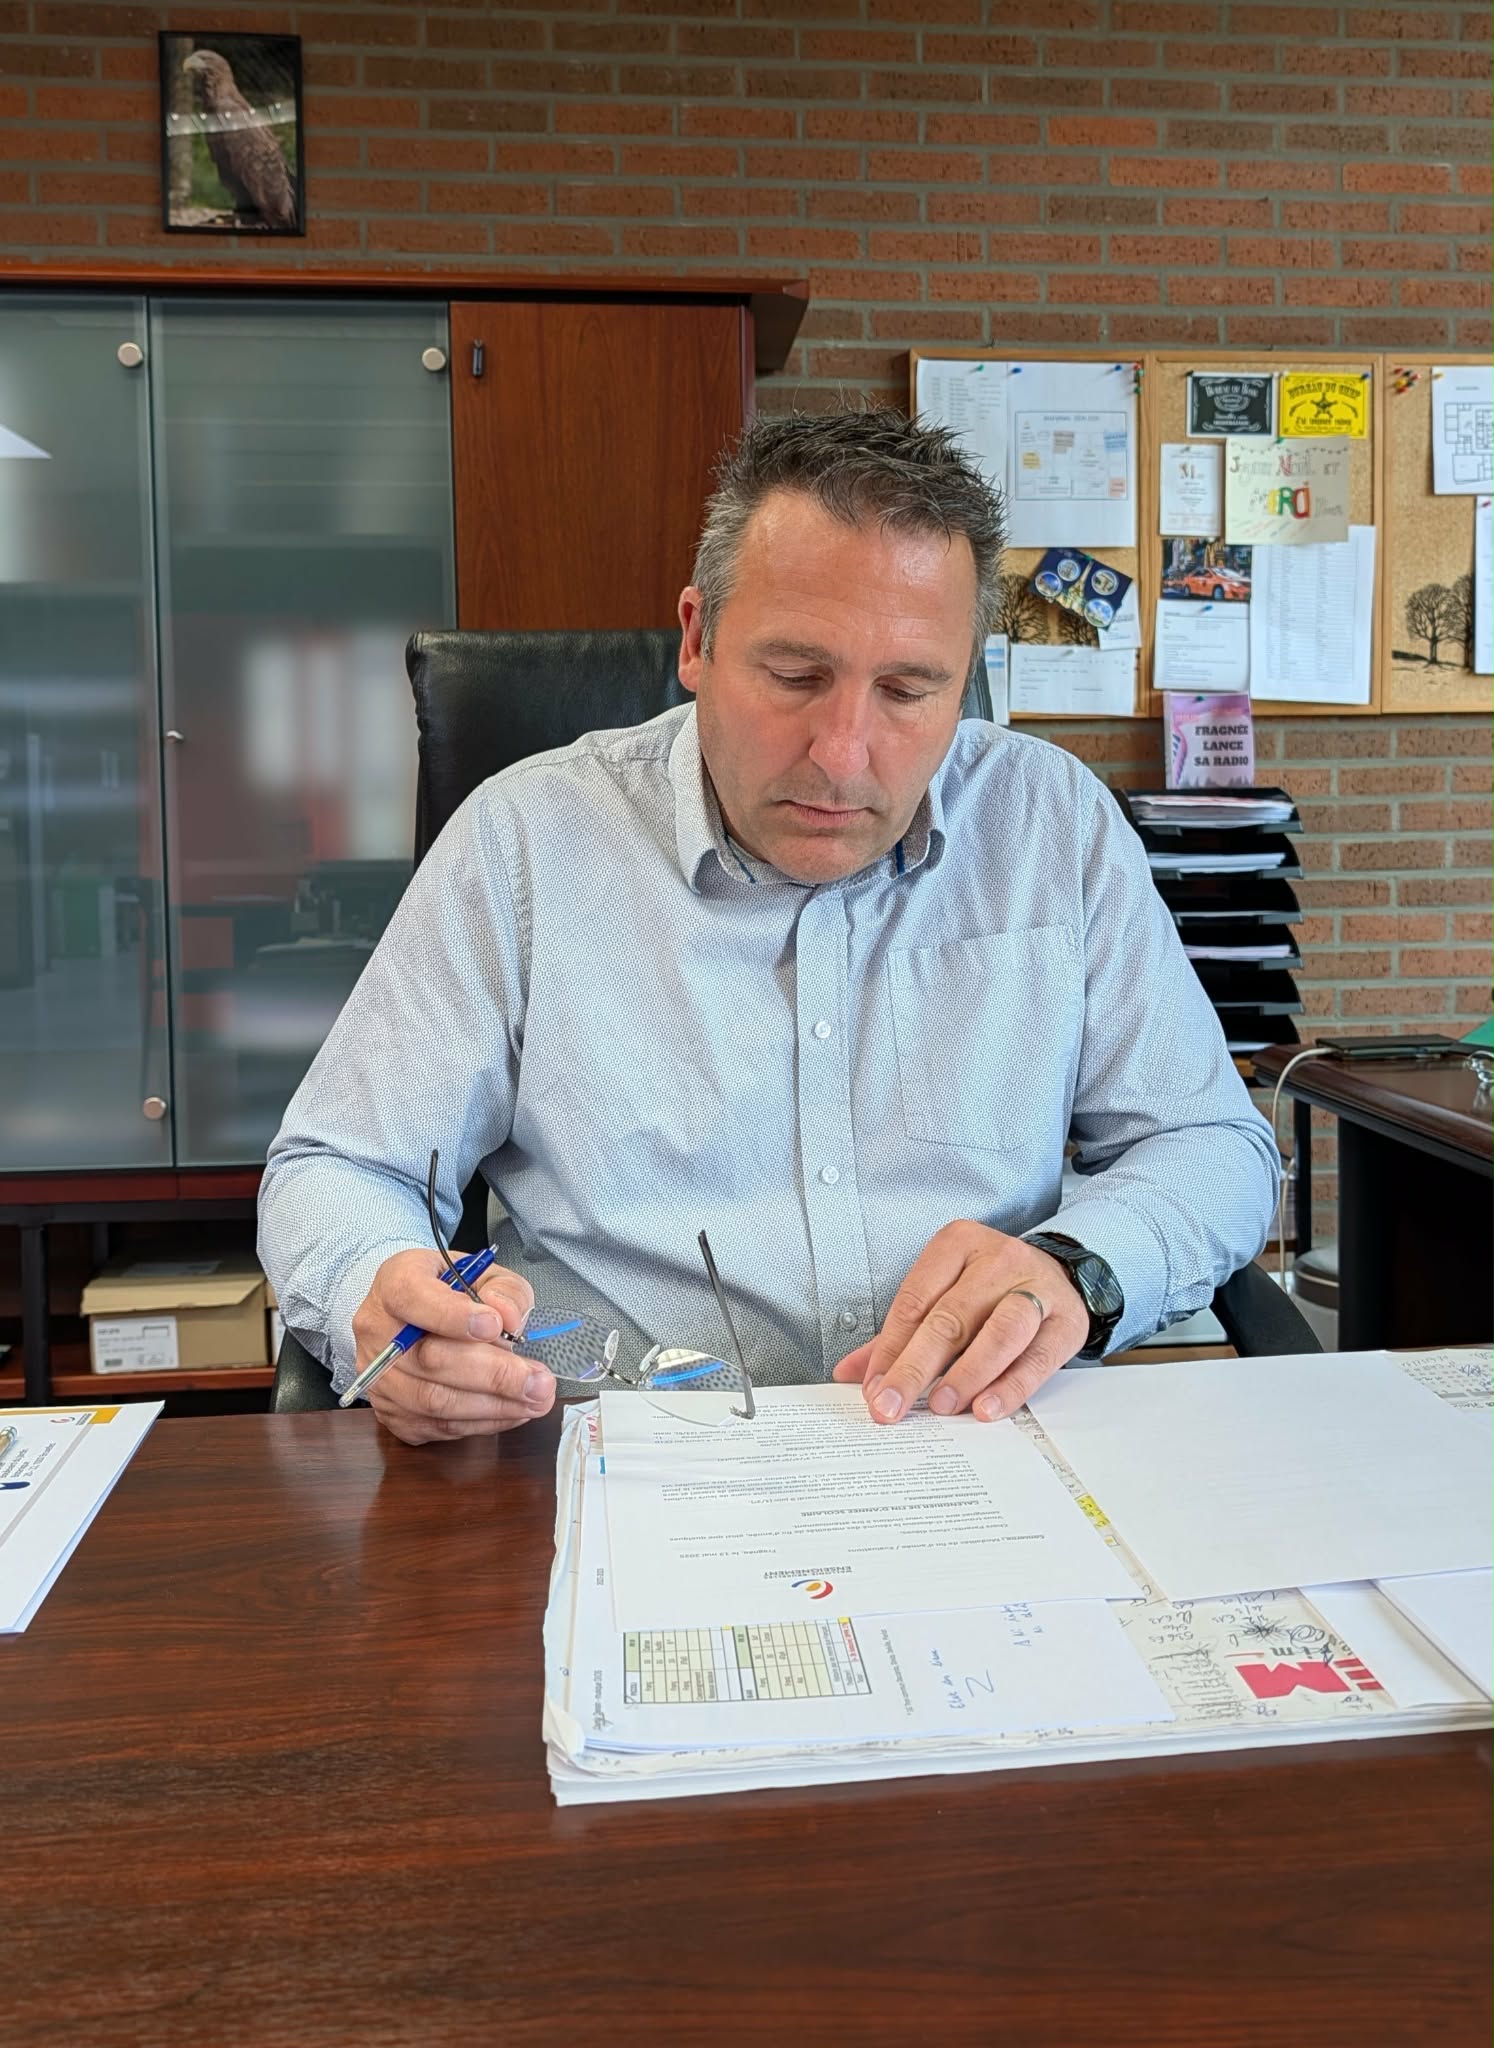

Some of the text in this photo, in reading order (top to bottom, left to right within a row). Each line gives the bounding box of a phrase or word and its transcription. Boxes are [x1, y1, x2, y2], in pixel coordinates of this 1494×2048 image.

[1202, 741, 1244, 751] LANCE
[1194, 756, 1249, 767] SA RADIO
[762, 1564, 852, 1576] ENSEIGNEMENT
